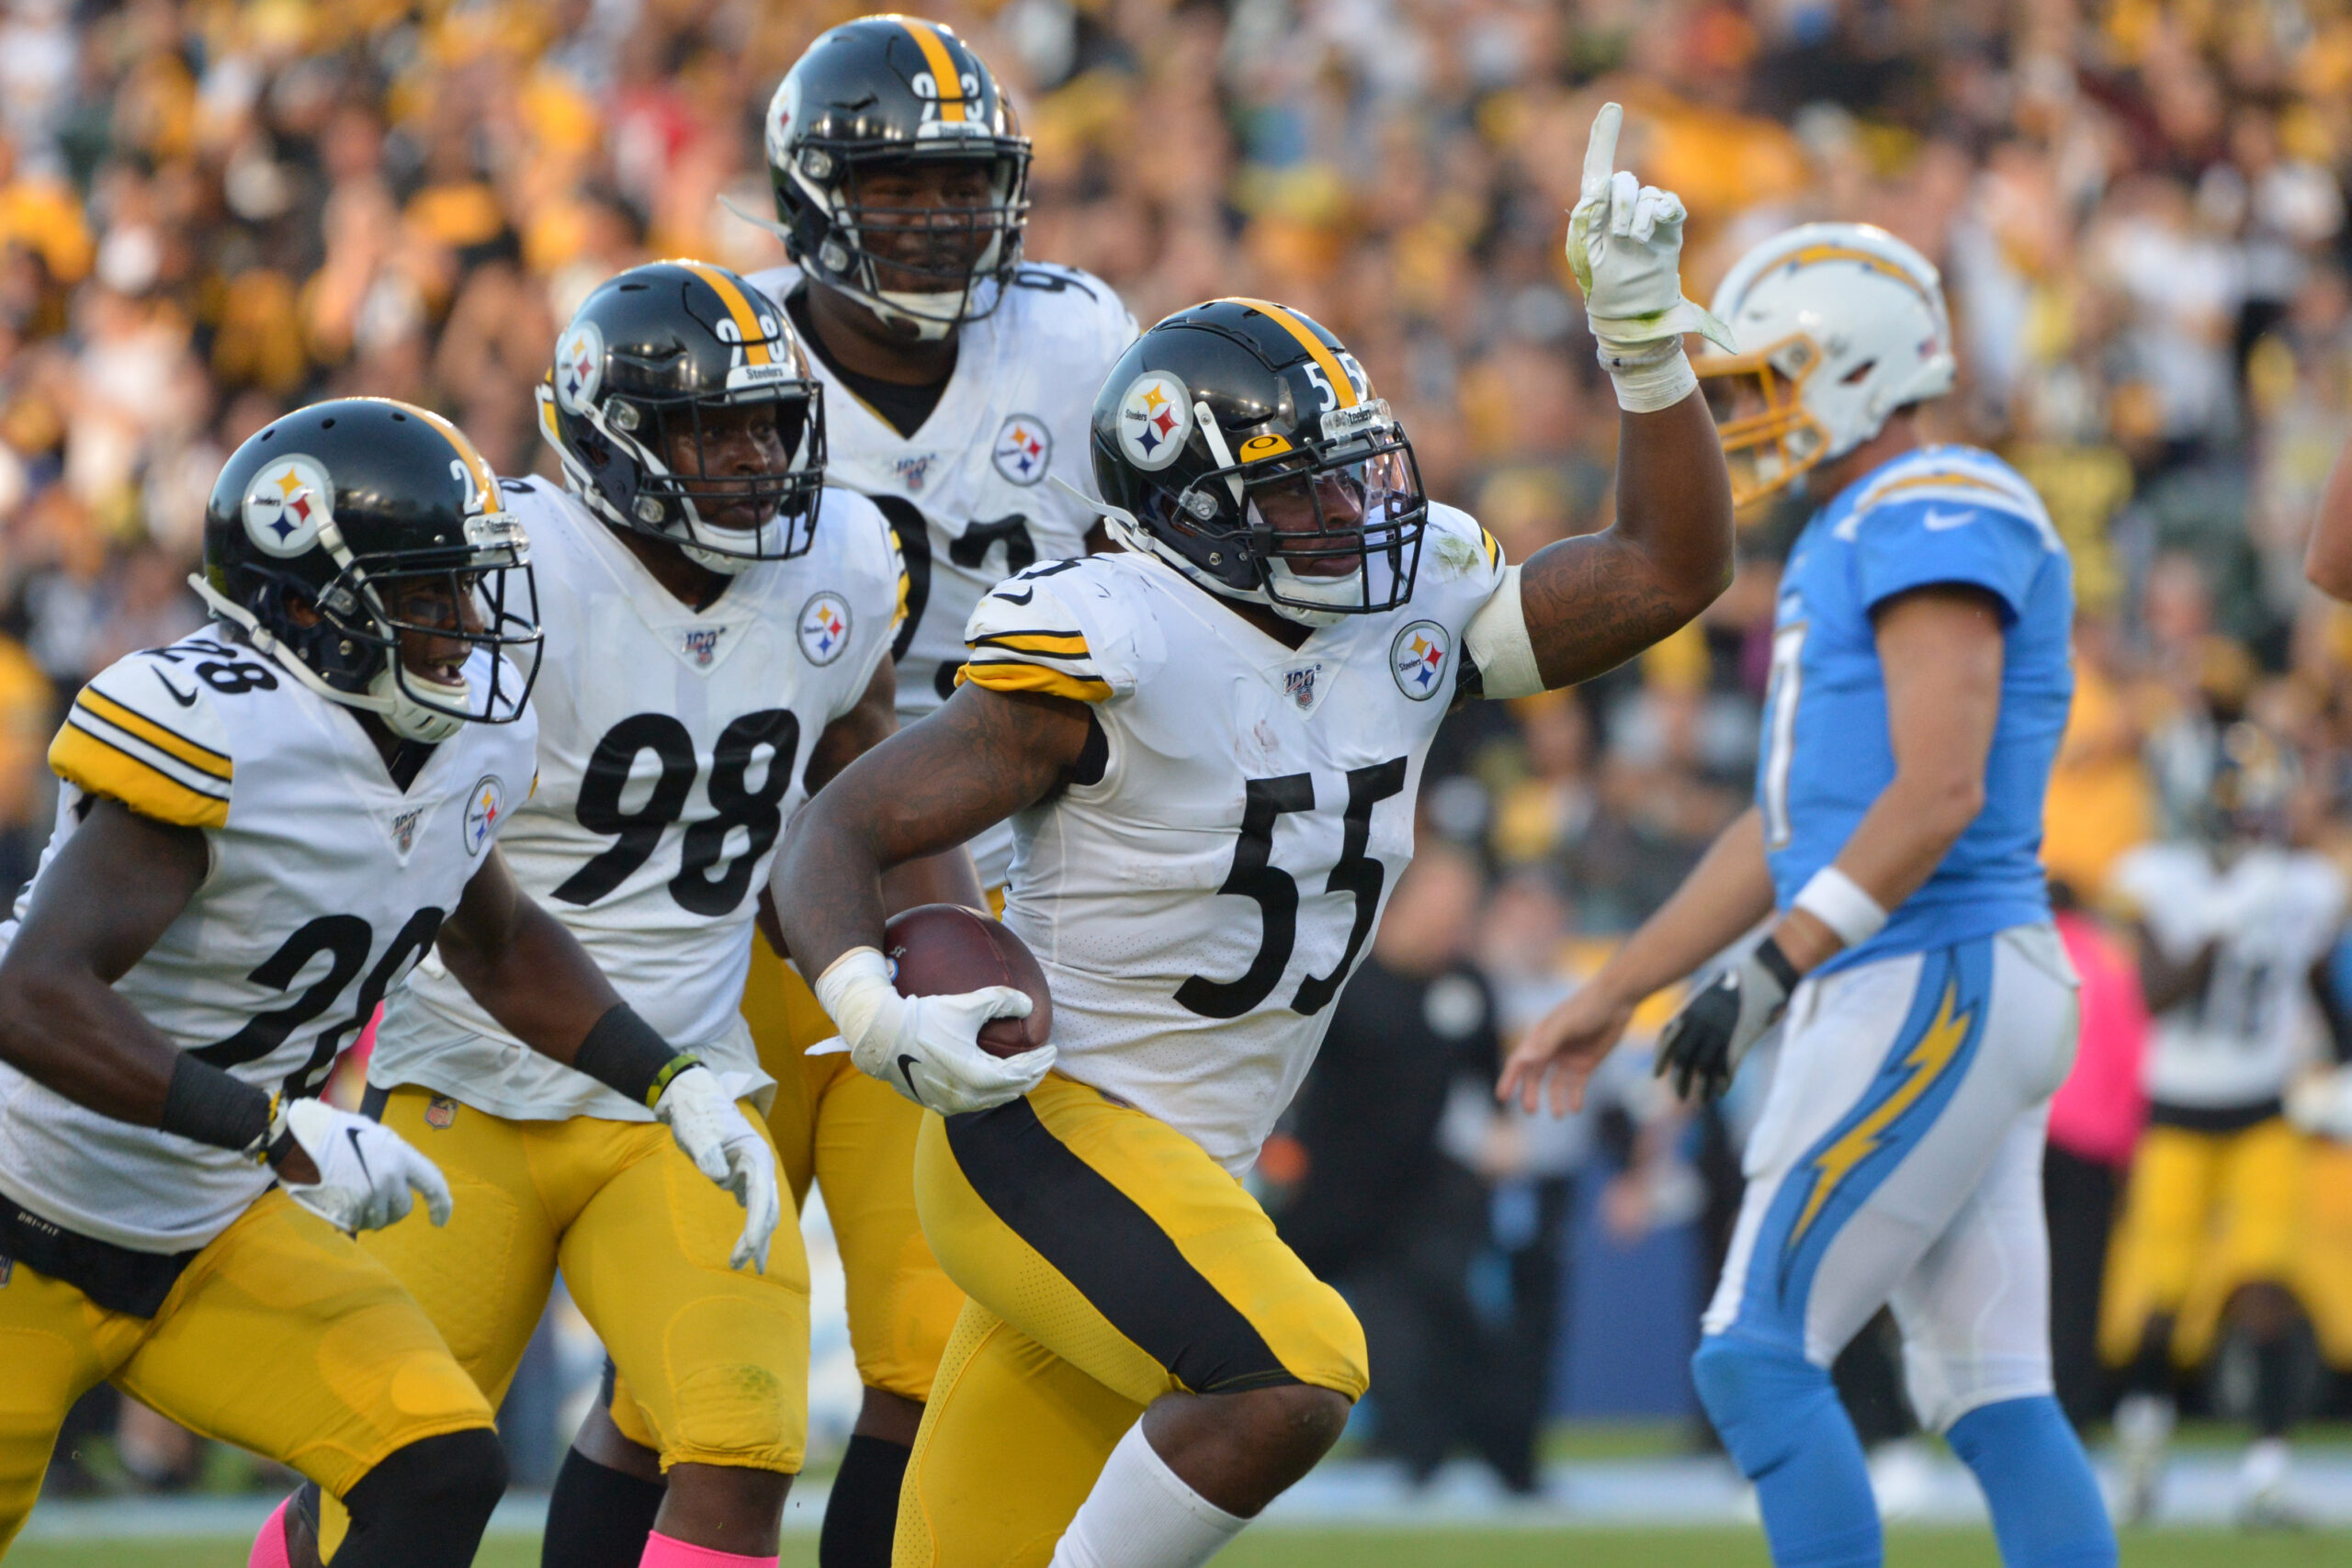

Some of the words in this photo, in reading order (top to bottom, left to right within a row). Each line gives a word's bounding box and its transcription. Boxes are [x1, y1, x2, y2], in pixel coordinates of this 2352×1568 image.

[912, 72, 984, 121] 93
[715, 313, 786, 368] 98
[745, 367, 784, 380] Steelers
[1302, 353, 1368, 412] 55
[1125, 408, 1148, 422] Steelers
[138, 638, 279, 695] 28
[1398, 659, 1421, 671] Steelers
[548, 707, 800, 917] 98
[1172, 754, 1408, 1020] 55
